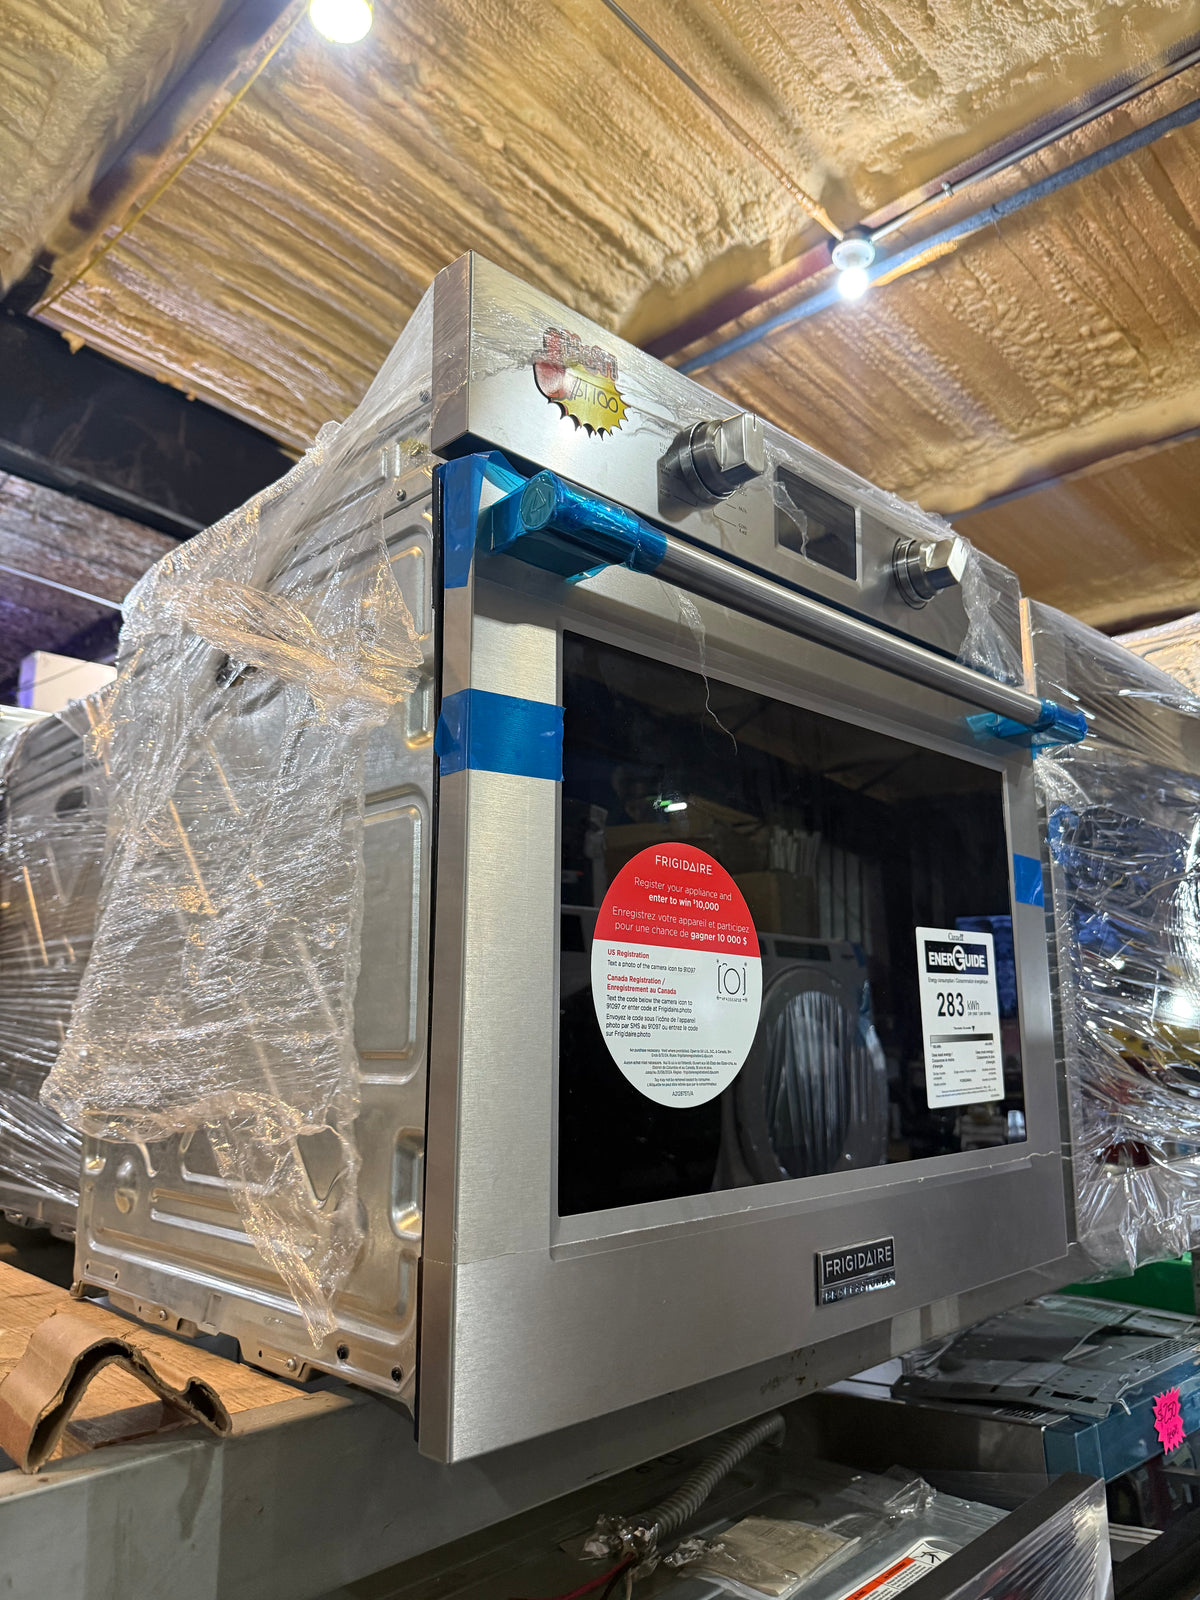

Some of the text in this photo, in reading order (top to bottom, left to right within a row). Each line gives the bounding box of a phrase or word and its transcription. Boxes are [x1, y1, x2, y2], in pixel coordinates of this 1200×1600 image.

[655, 854, 713, 876] FRIGIDAIRE
[634, 876, 732, 901] Register your appliance and
[648, 894, 719, 912] enter to win $10,000
[612, 906, 750, 934] Enregistrez votre appareil et participez
[615, 922, 747, 945] pour une chance de gagner 10 000 $
[617, 950, 649, 959] Registration
[928, 945, 986, 971] ENERGUIDE
[607, 984, 648, 992] Enregistrement
[629, 976, 661, 984] Registration
[937, 992, 980, 1017] 283 kWh
[826, 1246, 892, 1278] FRIGIDAIRE
